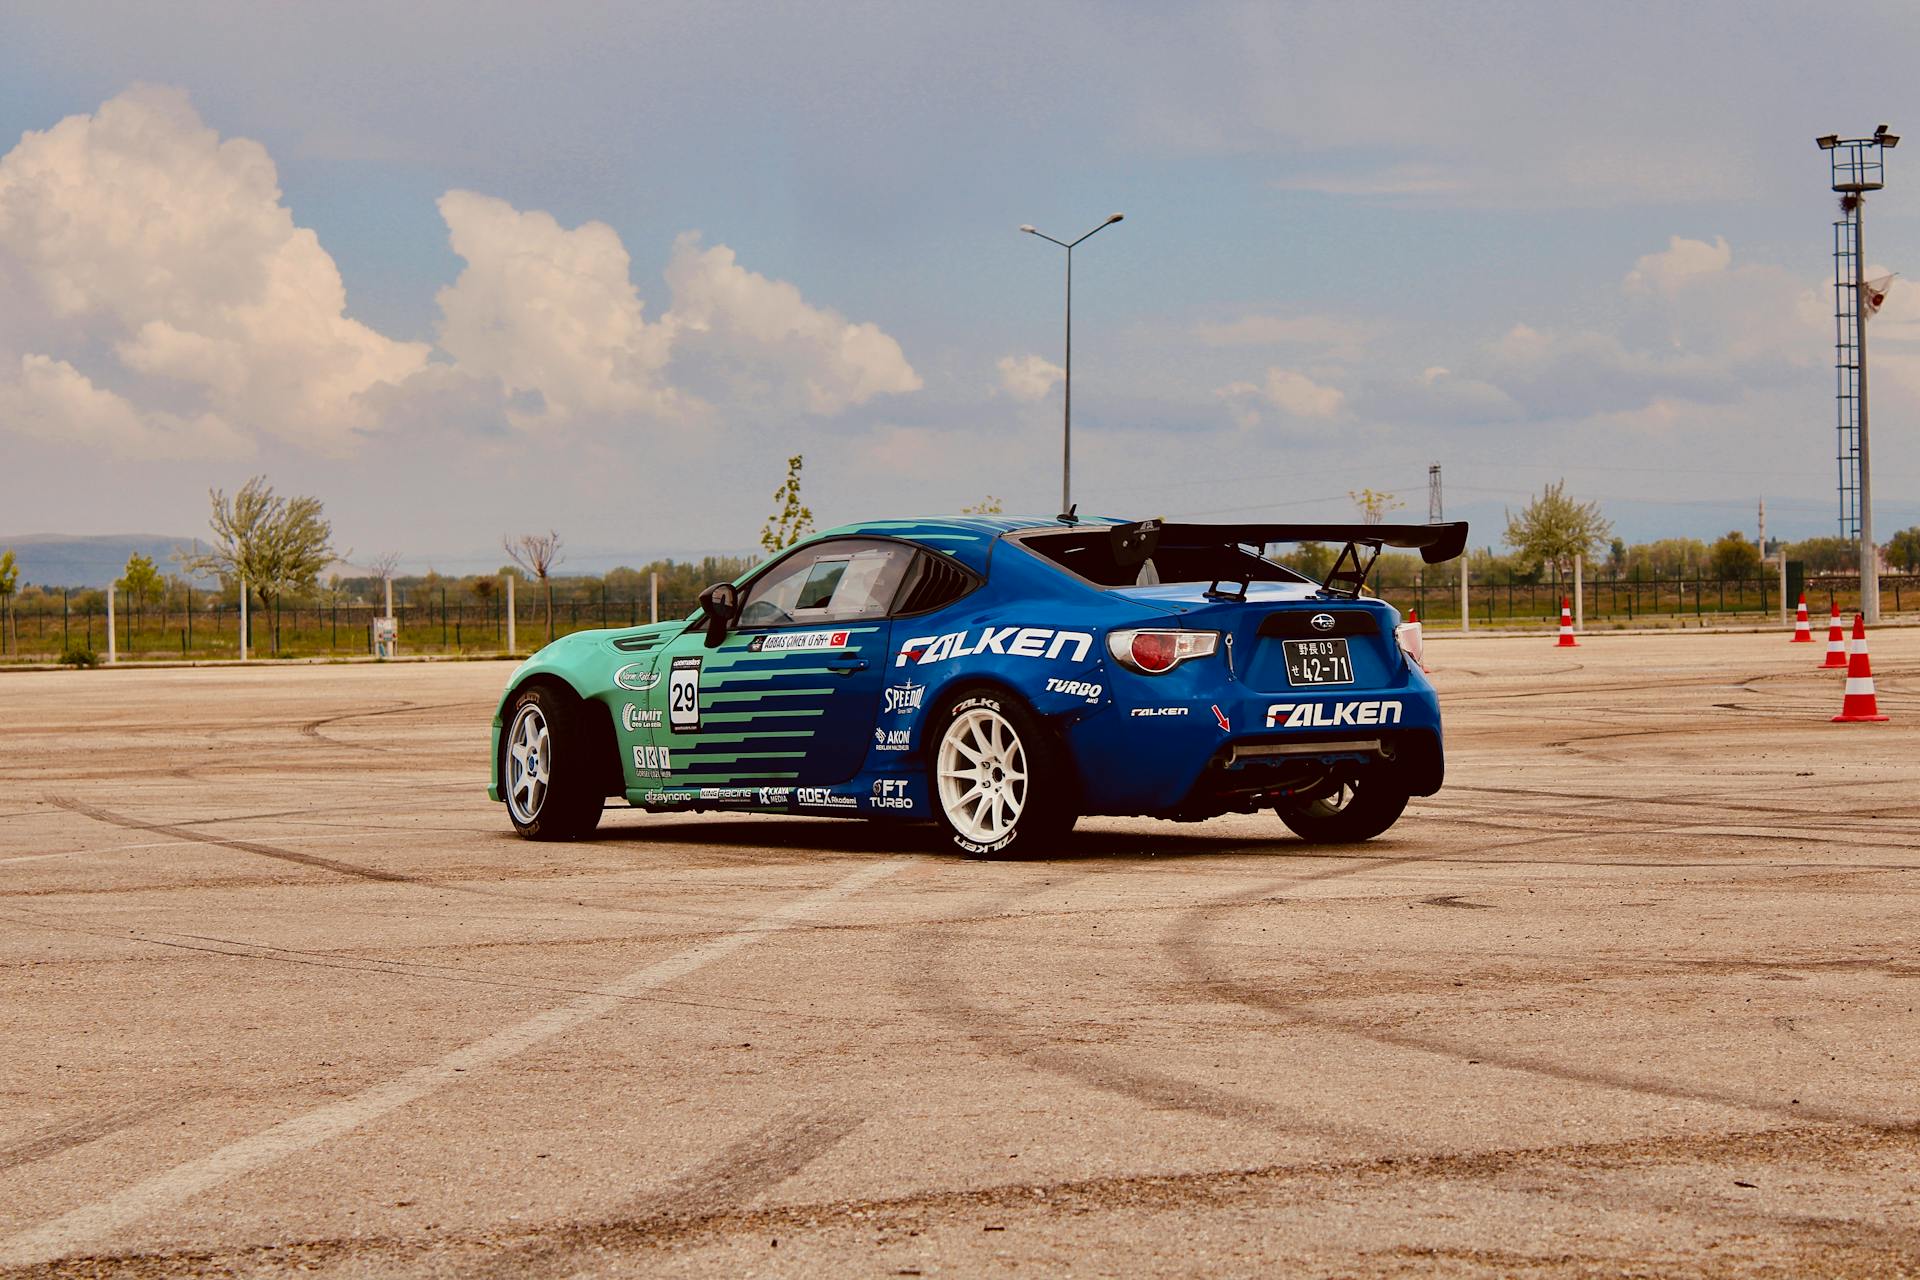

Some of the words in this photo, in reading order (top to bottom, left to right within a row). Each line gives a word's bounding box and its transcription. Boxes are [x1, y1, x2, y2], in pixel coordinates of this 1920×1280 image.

[764, 634, 785, 649] ABBAS
[895, 627, 1093, 667] FALKEN
[1303, 656, 1349, 681] 42-71
[672, 682, 695, 712] 29
[1045, 678, 1103, 697] TURBO
[952, 698, 1001, 716] FALKE
[1130, 707, 1189, 717] FALKEN
[1264, 701, 1403, 728] FALKEN
[635, 748, 668, 767] SKY
[882, 780, 909, 797] FT
[869, 797, 913, 809] TURBO
[953, 828, 1018, 854] FALKEN
